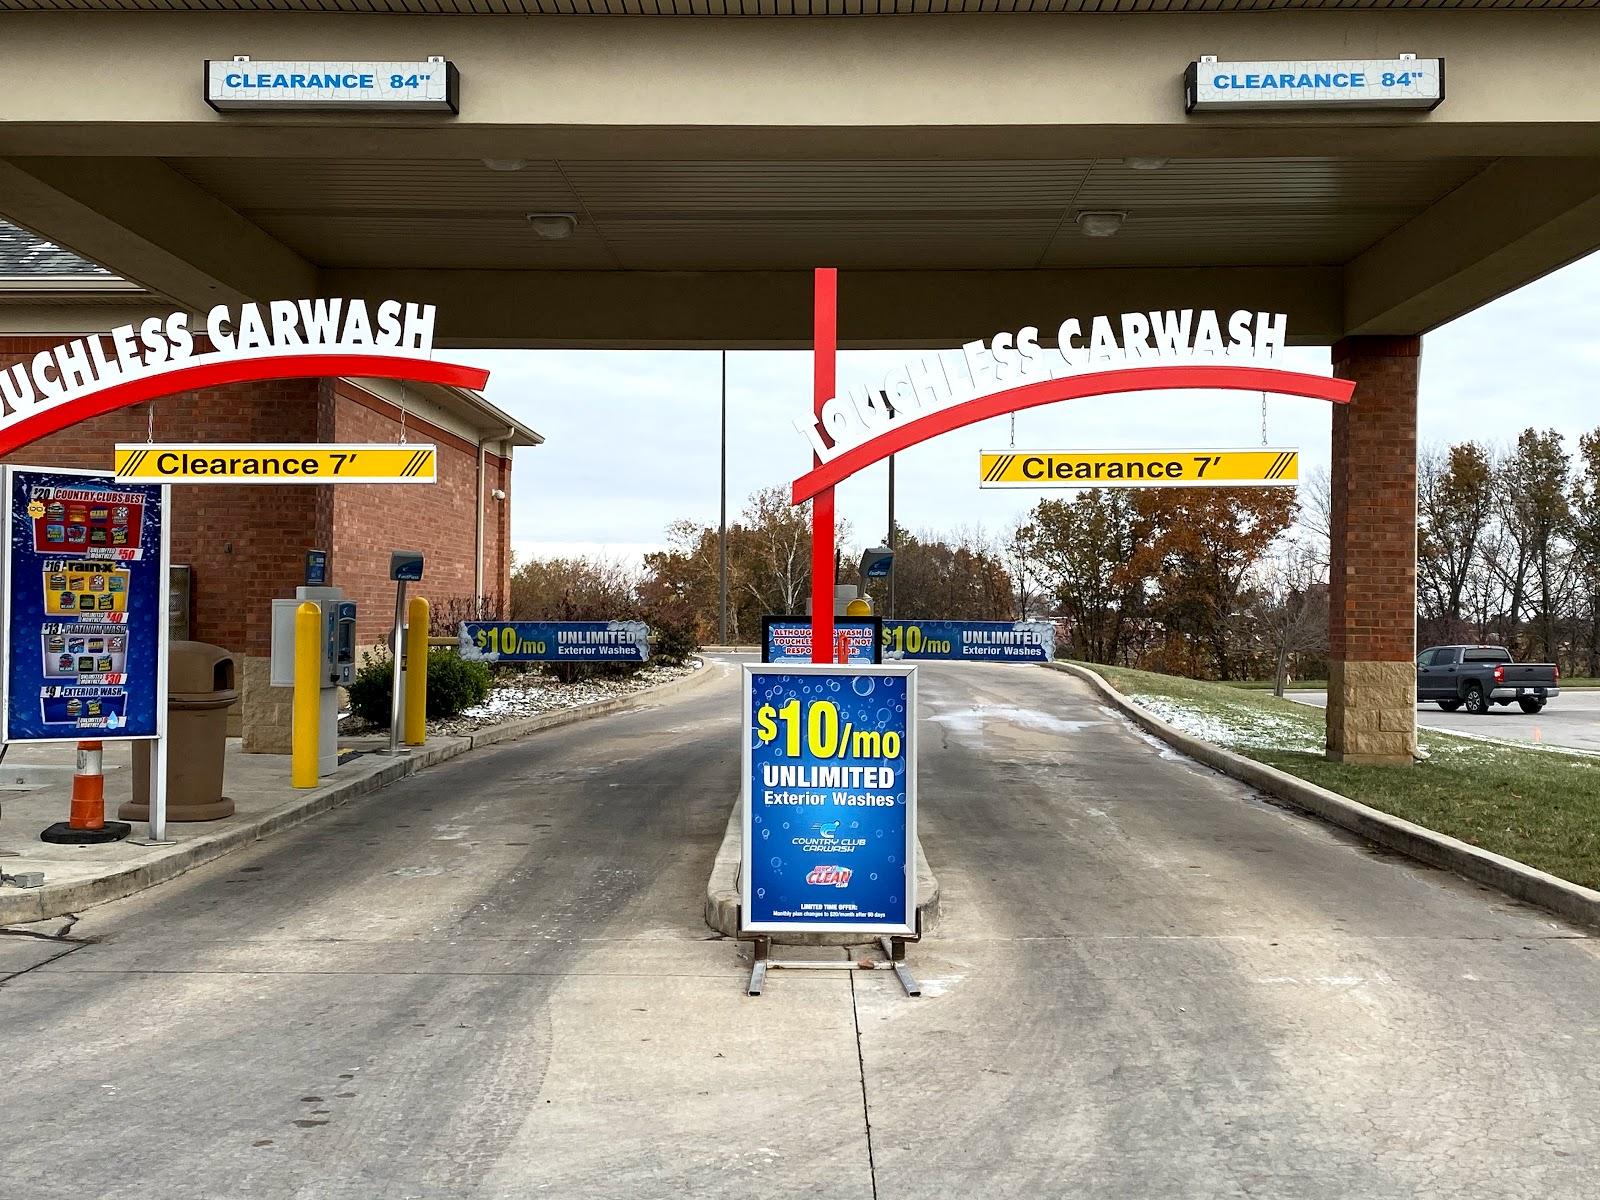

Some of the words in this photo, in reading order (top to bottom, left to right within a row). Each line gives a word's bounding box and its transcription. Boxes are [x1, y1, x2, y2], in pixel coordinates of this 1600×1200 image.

[225, 74, 374, 89] CLEARANCE
[390, 74, 431, 89] 84"
[1213, 73, 1365, 89] CLEARANCE
[1381, 72, 1423, 88] 84"
[0, 312, 194, 420] UCHLESS
[206, 297, 437, 354] CARWASH
[791, 326, 1048, 465] TOUCHLESS
[1057, 308, 1288, 366] CARWASH
[156, 452, 319, 475] Clearance
[1021, 456, 1183, 480] Clearance
[33, 487, 51, 500] $20
[55, 489, 94, 501] COUNTRY
[125, 494, 146, 504] BEST
[118, 548, 135, 560] $50
[45, 560, 61, 573] $16
[107, 612, 123, 623] $40
[44, 623, 60, 635] $13
[65, 624, 103, 635] PLATINUM
[103, 625, 127, 635] WASH
[773, 629, 812, 637] ALTHOUG
[476, 626, 546, 656] $10/mo
[557, 631, 636, 645] UNLIMITED
[774, 638, 812, 646] TOUCHLE
[854, 638, 872, 646] NOT
[882, 625, 951, 654] $10/mo
[962, 631, 1043, 645] UNLIMITED
[557, 645, 598, 656] Exterior
[599, 645, 637, 656] Washes
[962, 645, 1003, 656] Exterior
[1004, 645, 1042, 656] Washes
[105, 674, 122, 684] $30
[45, 686, 57, 697] $9
[64, 687, 99, 697] EXTERIOR
[100, 687, 123, 696] WASH
[757, 700, 901, 761] $10/mo
[763, 766, 896, 789] UNLIMITED
[764, 791, 826, 806] Exterior
[832, 791, 895, 807] Washes
[791, 837, 840, 846] COUNTRY
[803, 845, 854, 853] CARWASH
[808, 871, 851, 884] CLEAN
